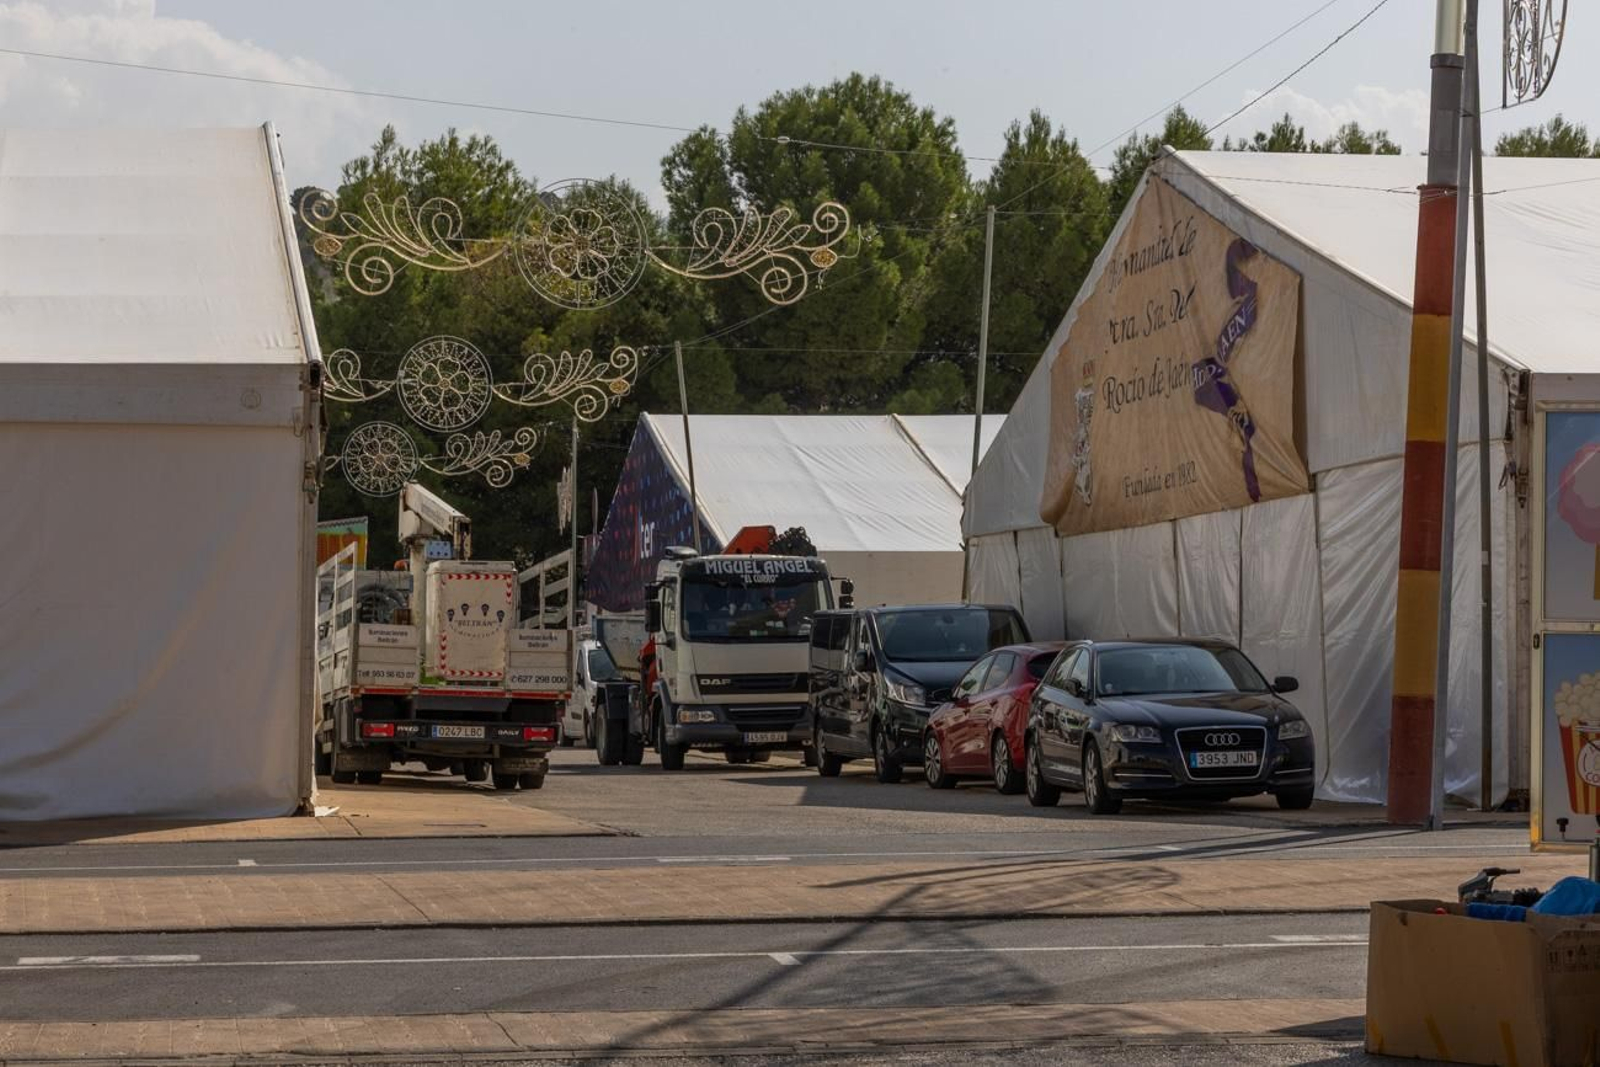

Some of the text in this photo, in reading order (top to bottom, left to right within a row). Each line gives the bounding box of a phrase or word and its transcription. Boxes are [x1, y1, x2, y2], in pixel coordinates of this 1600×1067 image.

[704, 559, 813, 574] MIGUEL ANGEL
[700, 678, 731, 686] DAF
[438, 727, 461, 738] 0247
[1198, 752, 1254, 765] 3953 JND
